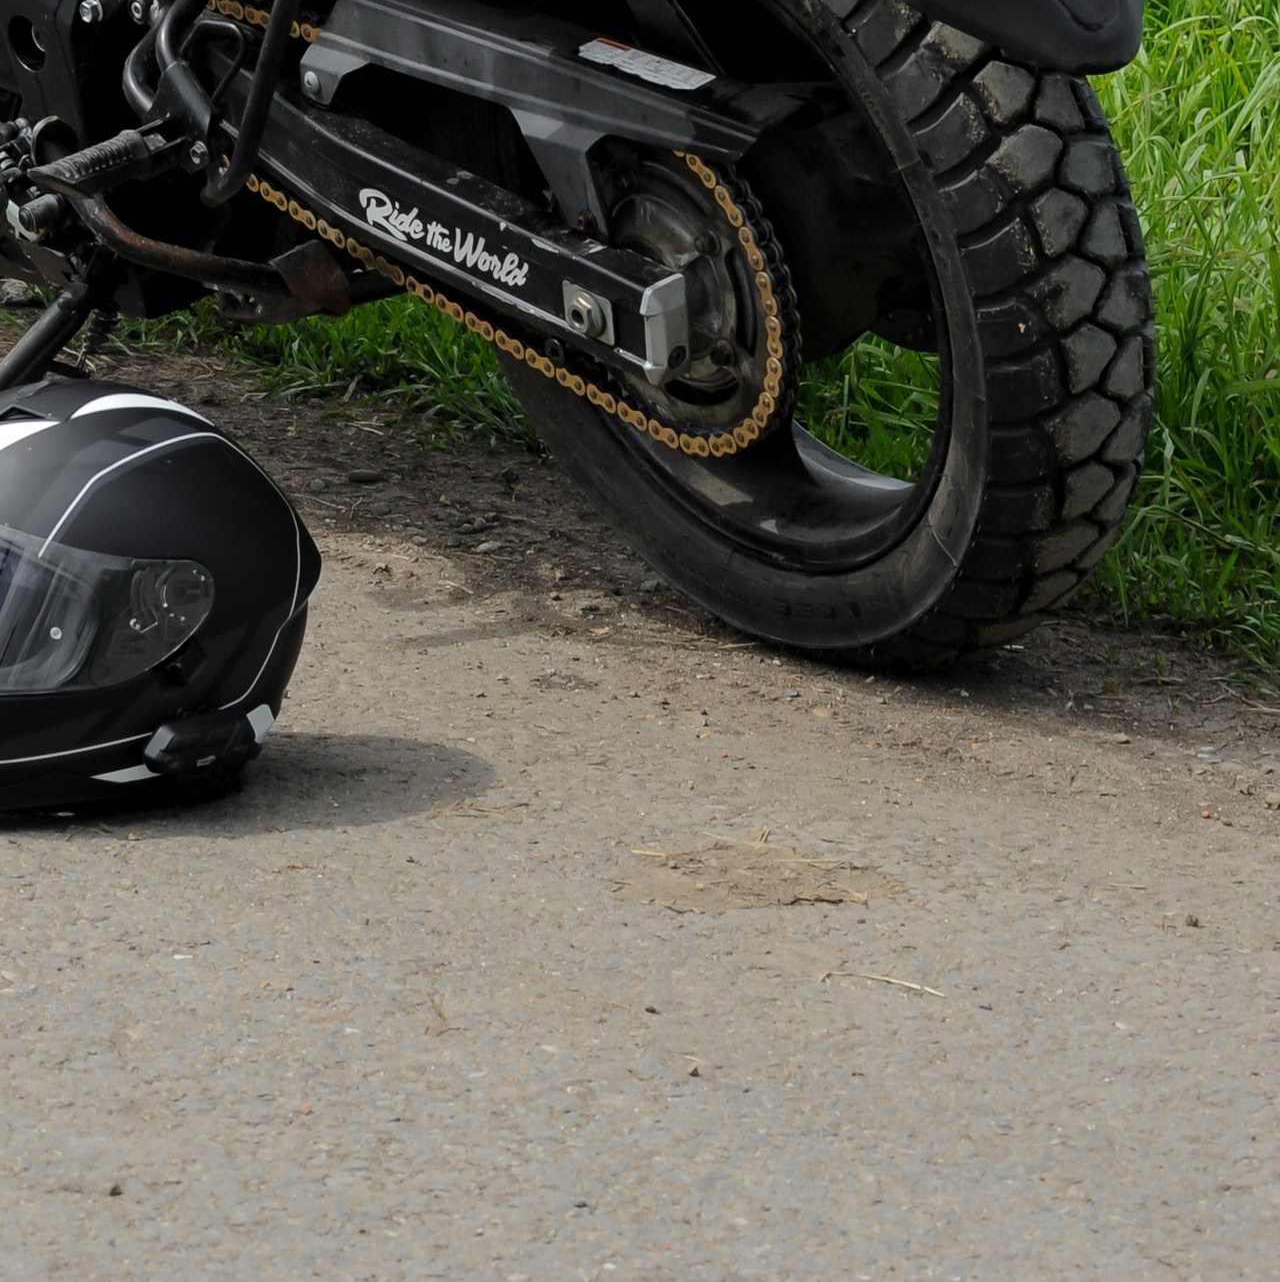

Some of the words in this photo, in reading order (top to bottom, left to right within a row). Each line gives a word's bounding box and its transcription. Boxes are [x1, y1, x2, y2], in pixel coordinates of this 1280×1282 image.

[359, 188, 425, 243] Ride
[425, 220, 453, 254] the
[453, 227, 529, 287] World
